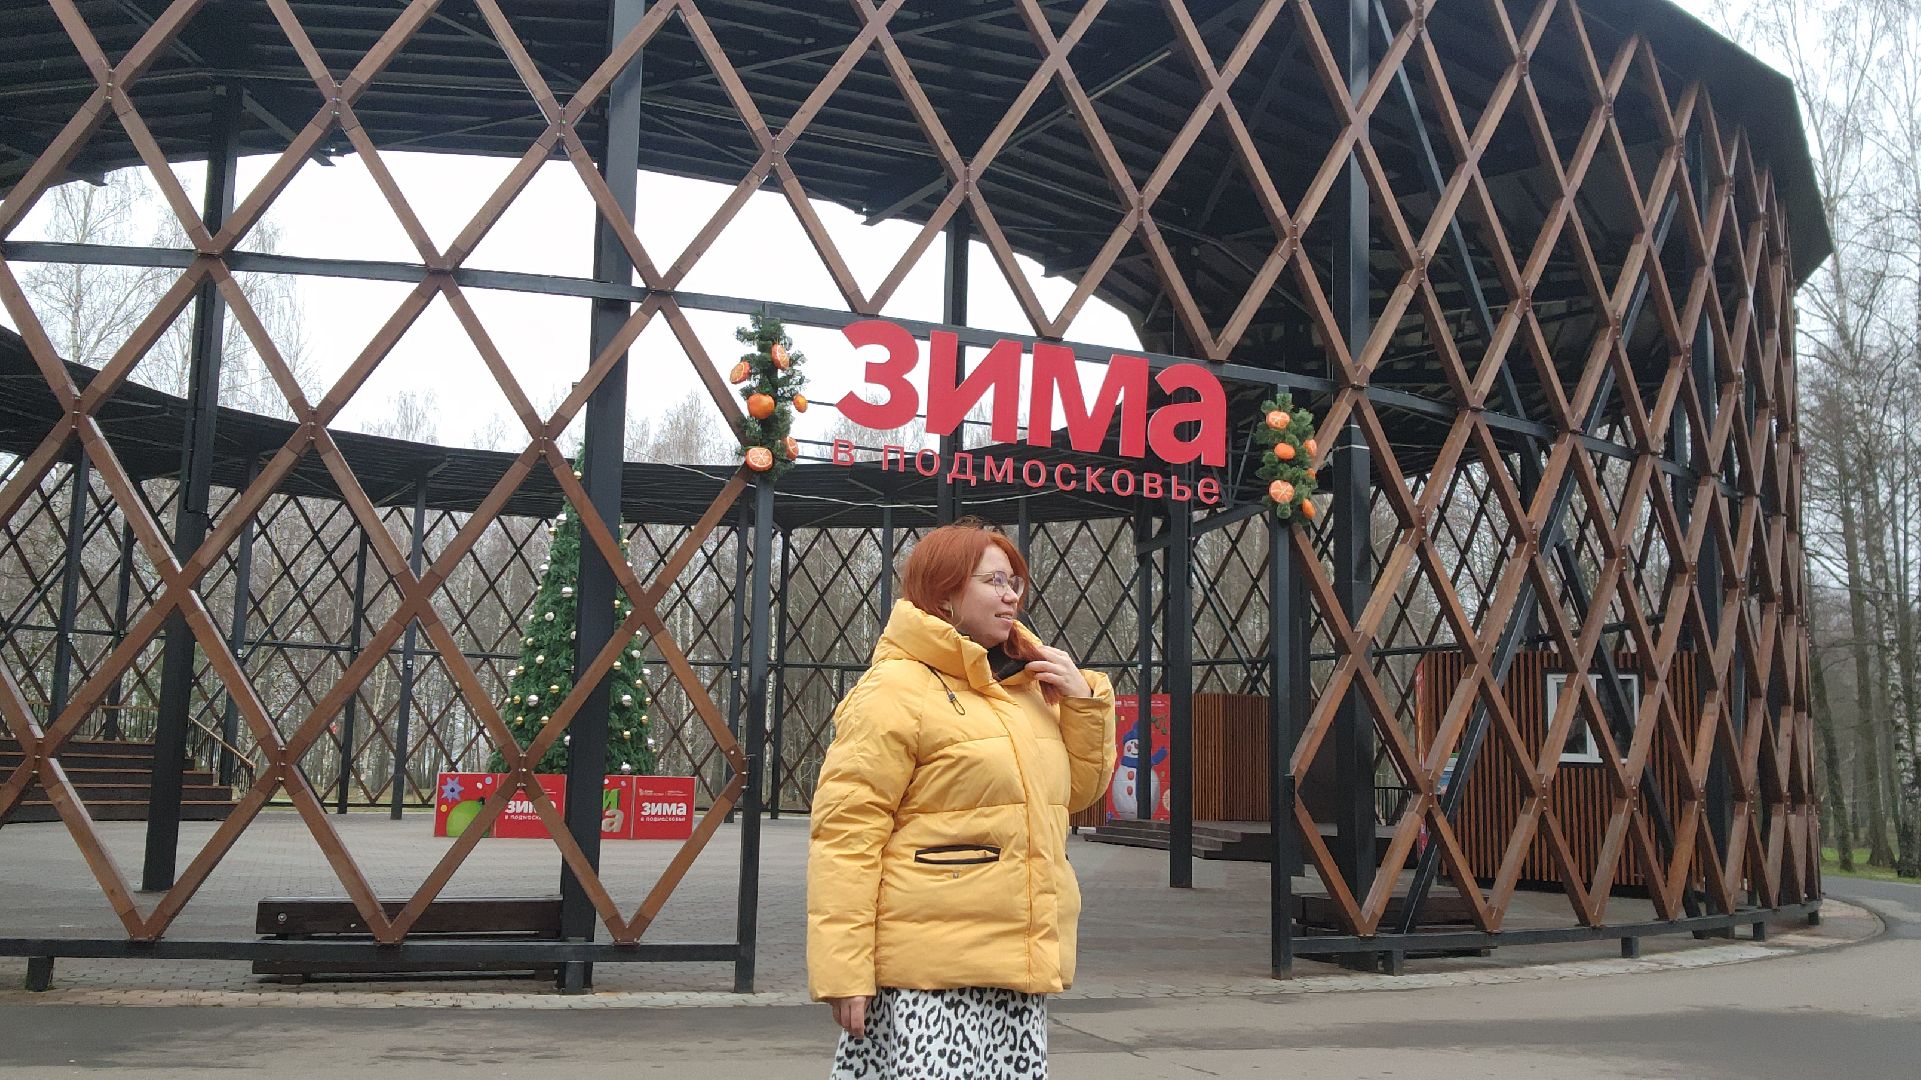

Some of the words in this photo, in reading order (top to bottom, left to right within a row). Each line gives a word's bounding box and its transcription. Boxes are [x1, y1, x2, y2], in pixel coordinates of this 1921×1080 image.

[834, 319, 1227, 468] зима
[832, 438, 855, 467] в
[881, 444, 1220, 505] подмосковье
[640, 802, 687, 816] зима
